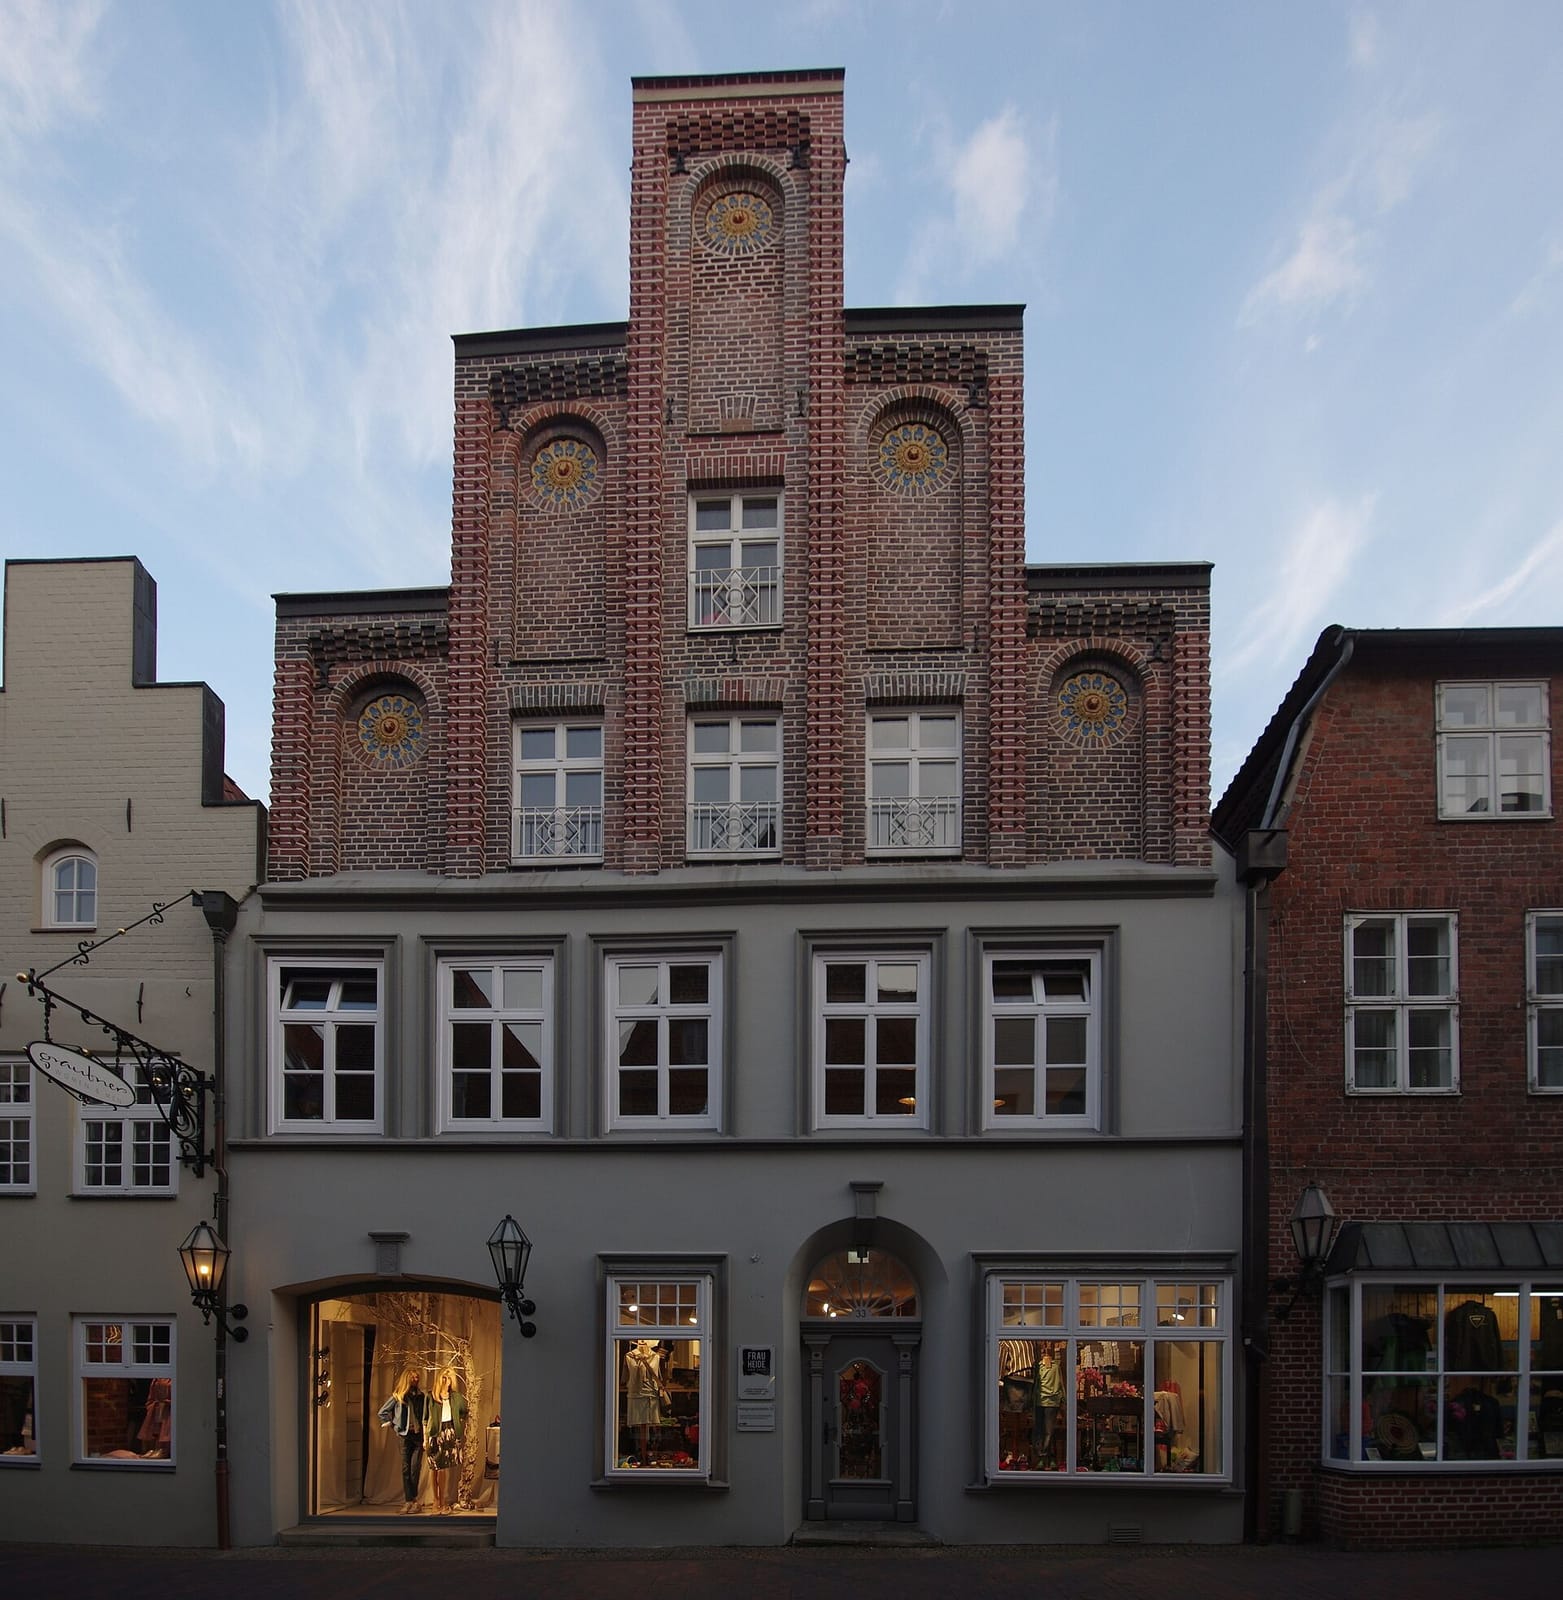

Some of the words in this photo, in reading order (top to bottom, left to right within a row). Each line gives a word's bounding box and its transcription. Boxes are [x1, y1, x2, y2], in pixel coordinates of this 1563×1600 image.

[39, 1051, 128, 1094] graubner
[747, 1351, 766, 1360] FRAU
[747, 1360, 766, 1369] HEIDE
